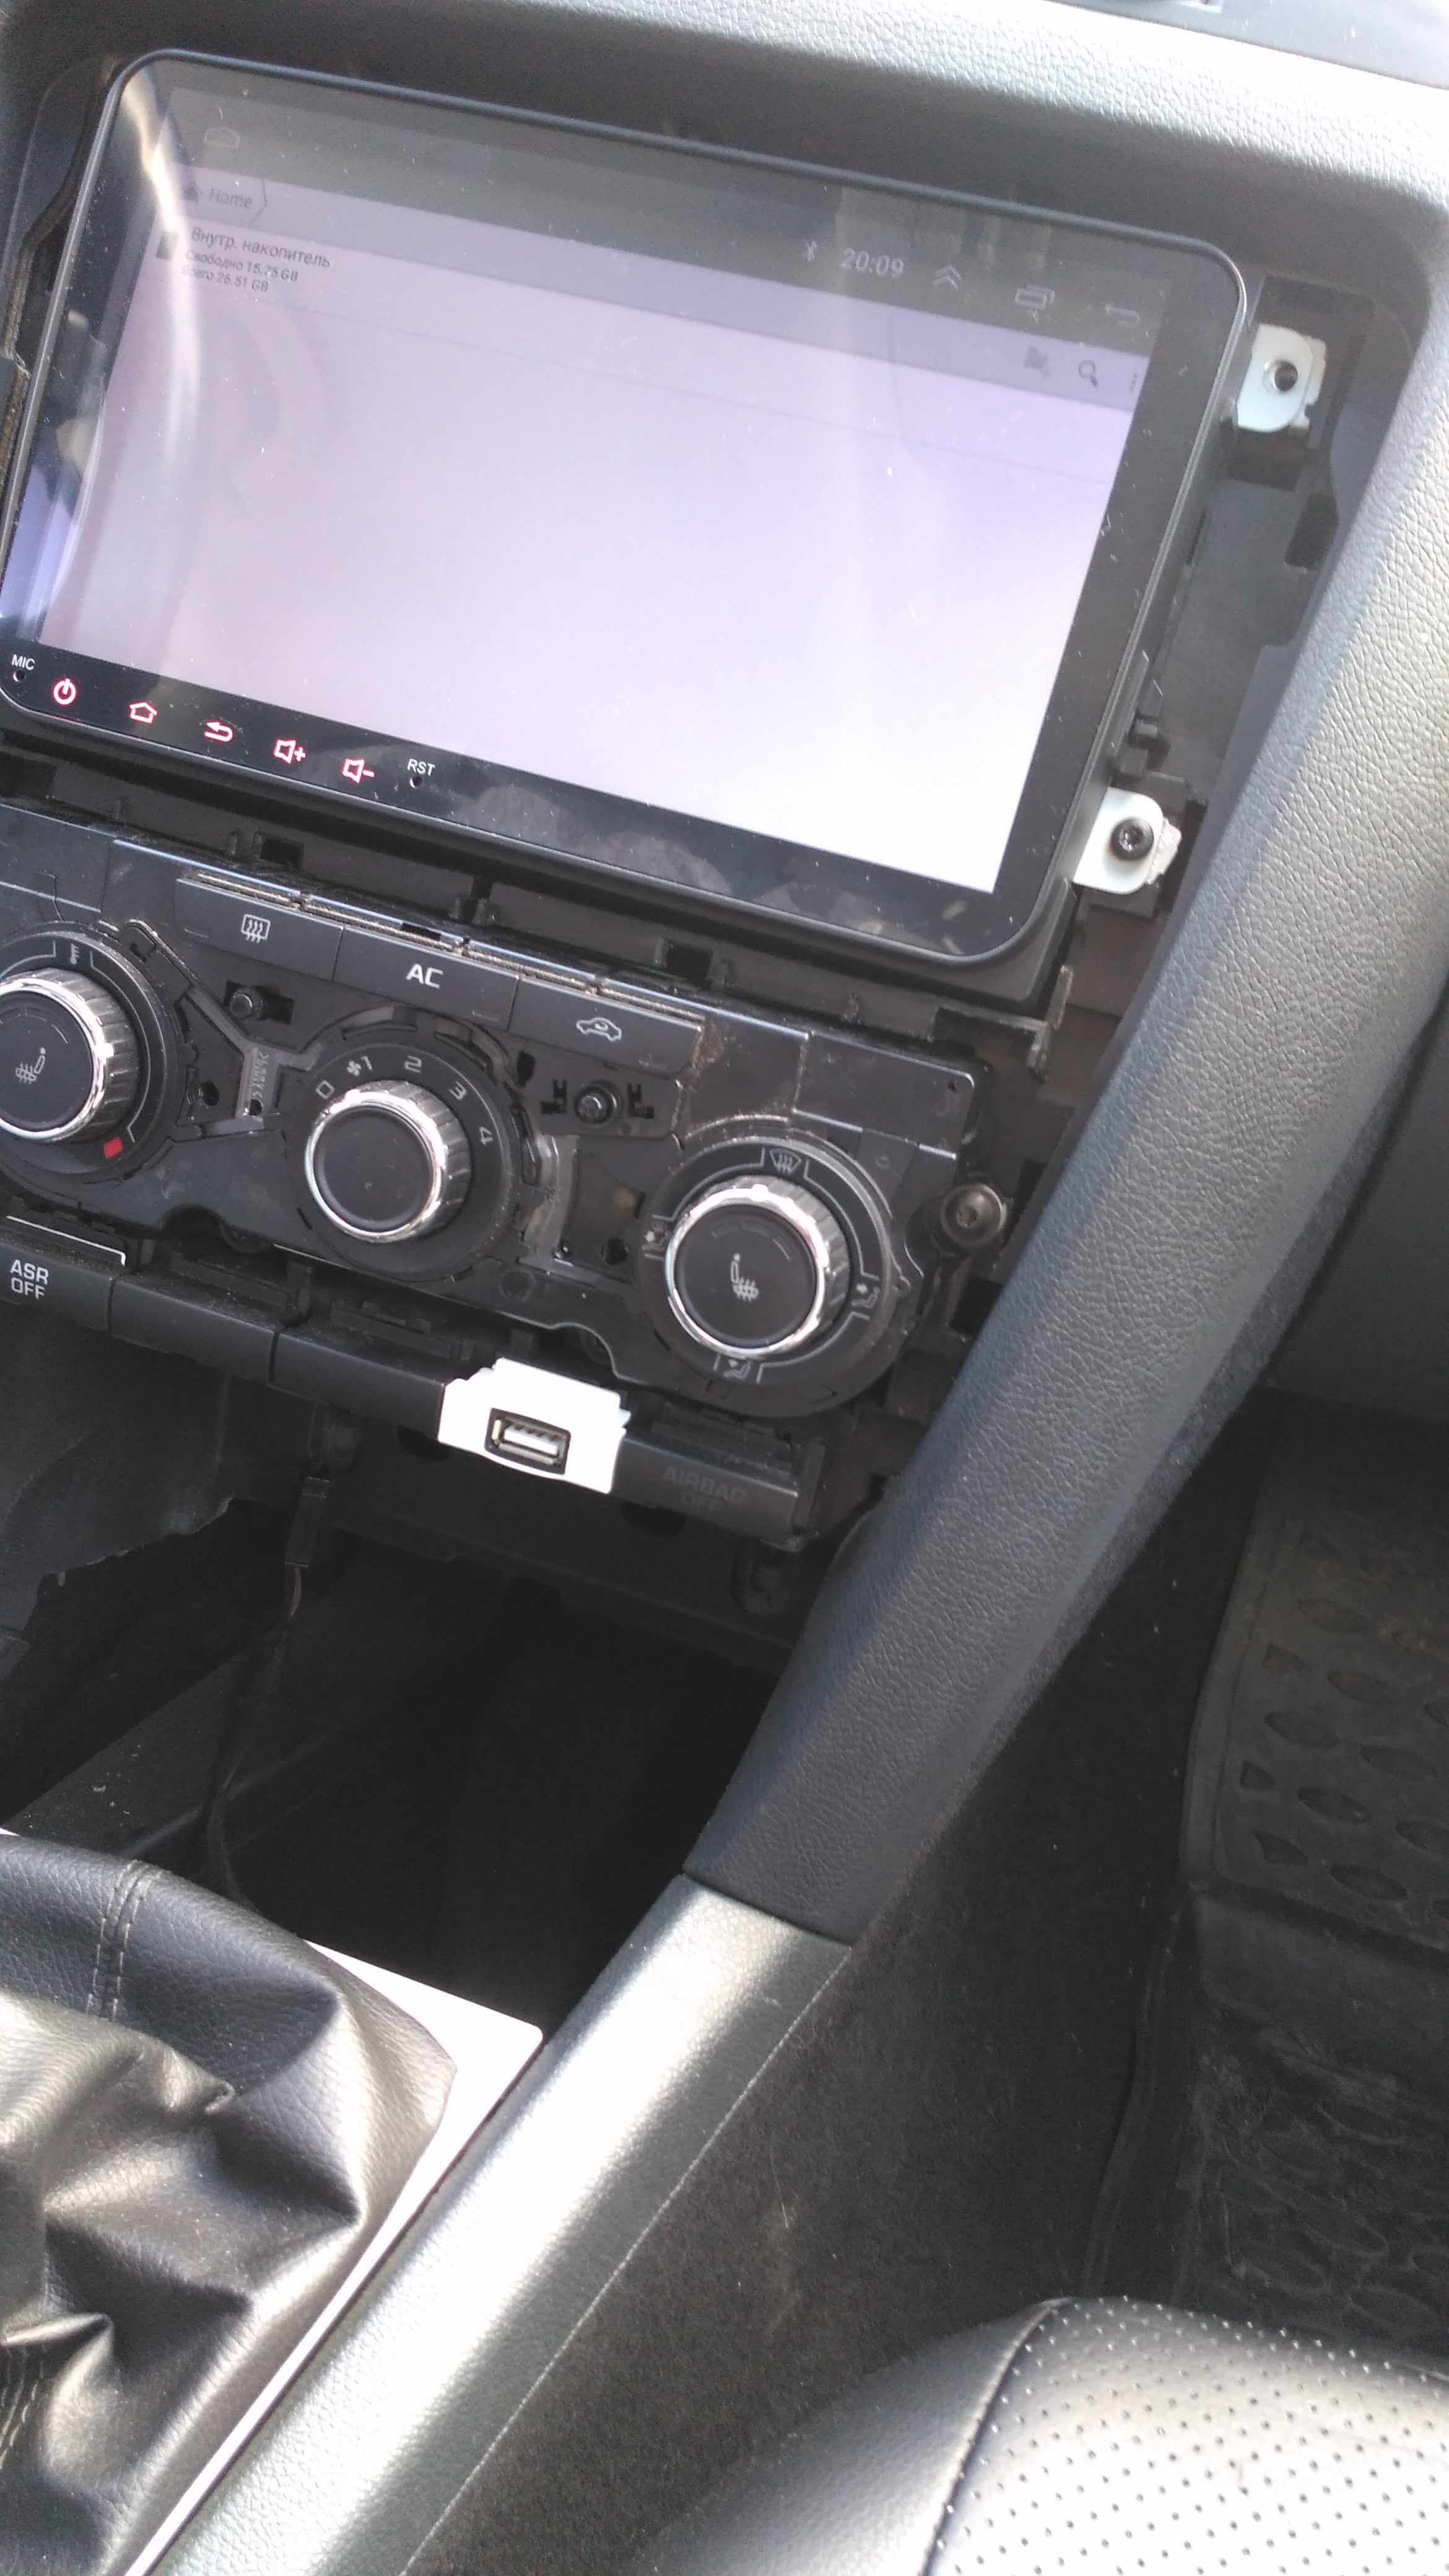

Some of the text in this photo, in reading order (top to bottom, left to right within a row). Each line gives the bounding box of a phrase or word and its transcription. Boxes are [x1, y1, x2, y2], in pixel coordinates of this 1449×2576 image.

[209, 188, 253, 209] Home
[191, 227, 331, 268] Внутр. накопитель
[841, 248, 904, 278] 20:09
[281, 268, 299, 282] GB
[251, 279, 270, 293] GB
[11, 654, 35, 671] MIC
[407, 759, 436, 777] RST
[406, 963, 444, 989] AC
[404, 1055, 422, 1073] 2
[449, 1081, 467, 1100] 3
[479, 1126, 494, 1145] 4
[10, 1259, 49, 1285] ASR
[11, 1277, 45, 1299] OFF
[661, 1466, 747, 1505] AIRBAG
